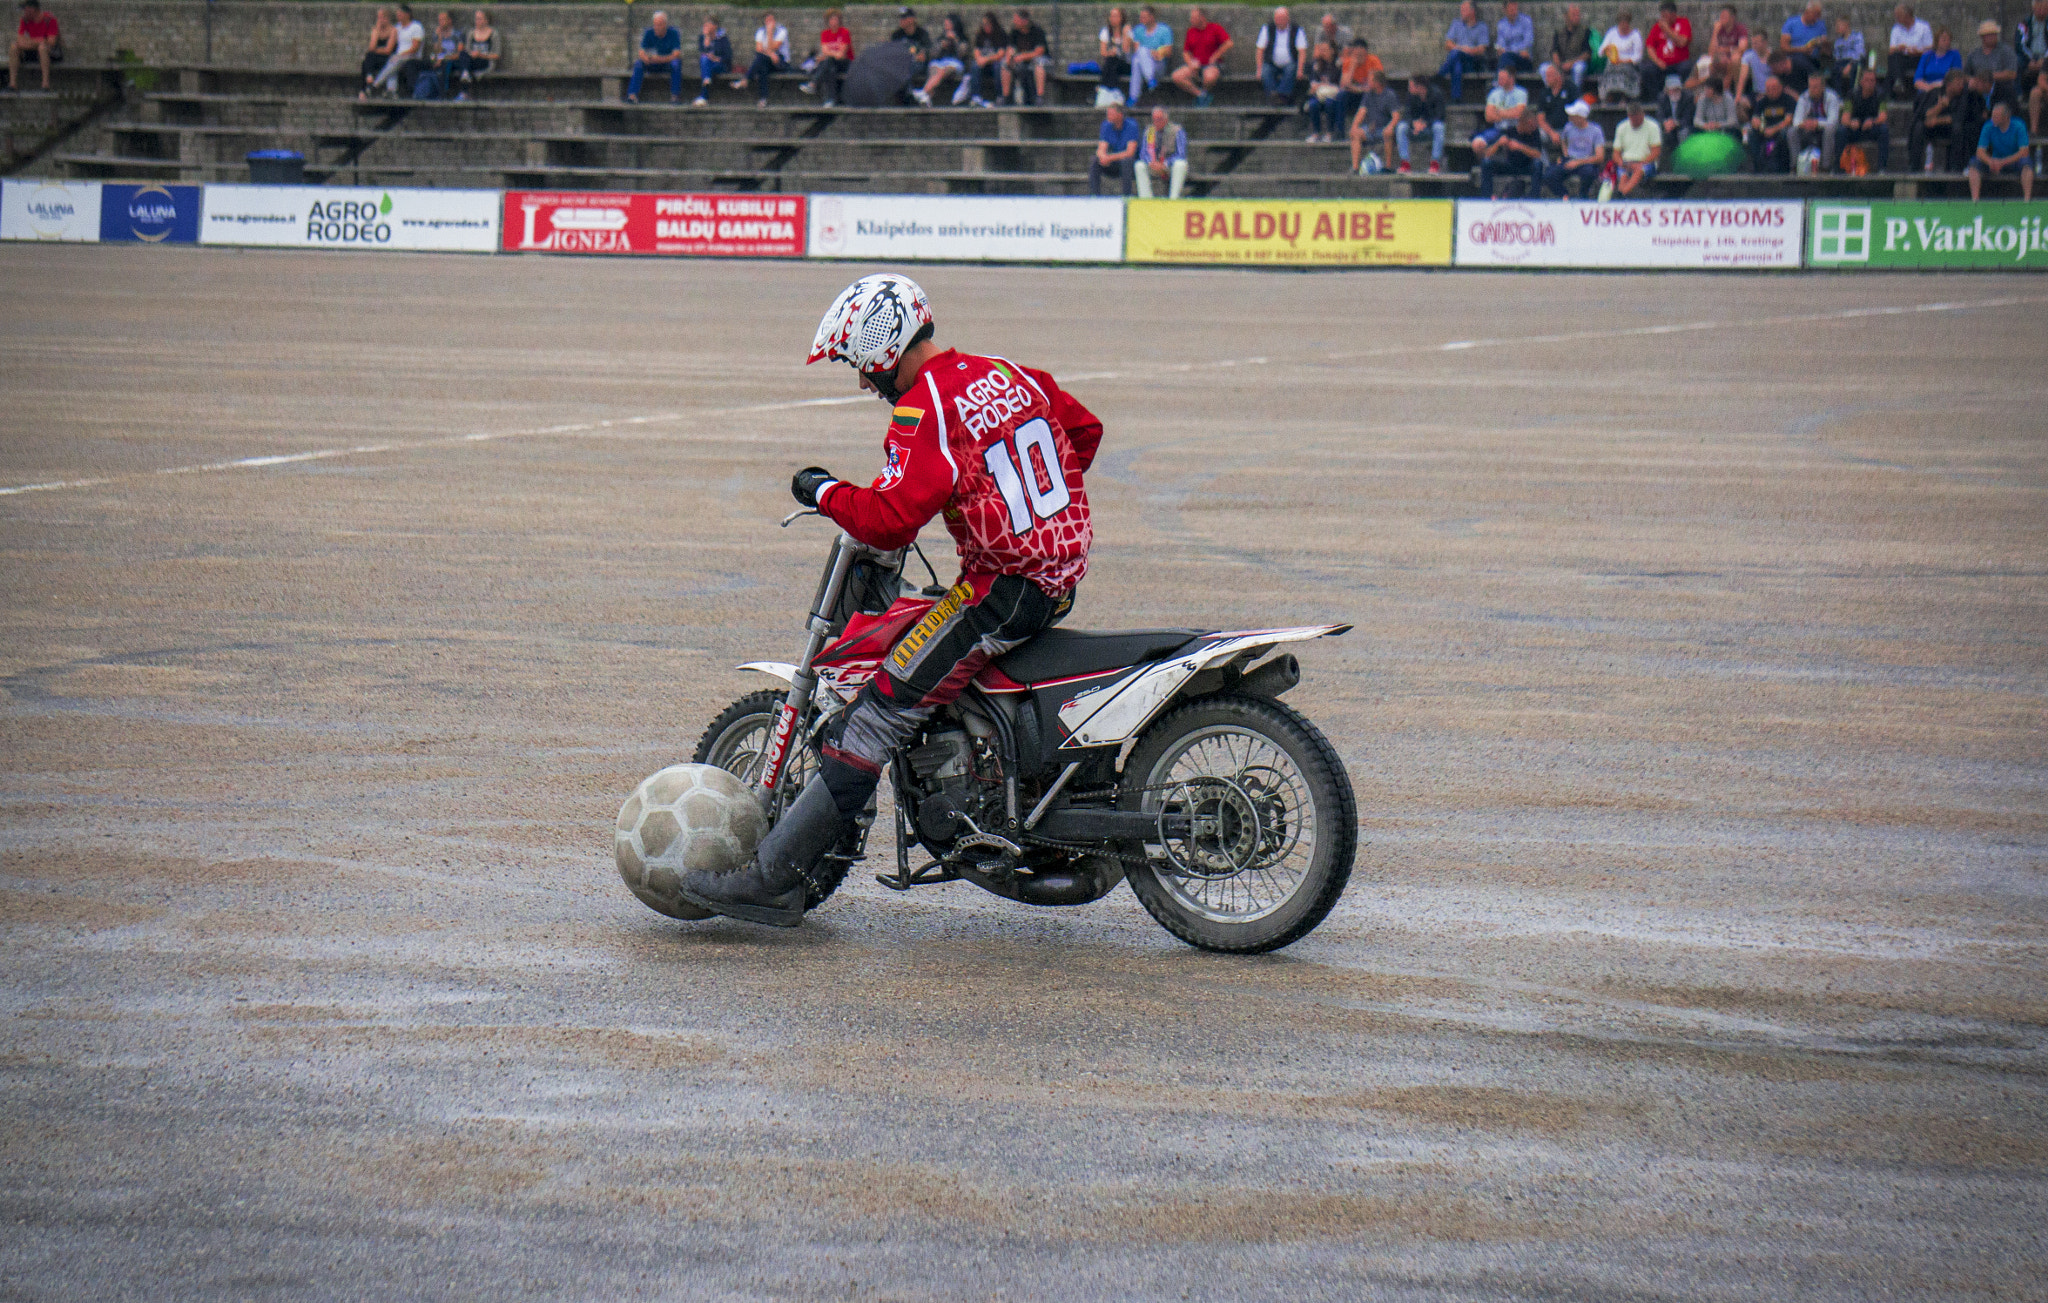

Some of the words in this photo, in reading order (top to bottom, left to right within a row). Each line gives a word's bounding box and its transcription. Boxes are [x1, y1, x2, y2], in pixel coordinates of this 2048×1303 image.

[129, 203, 177, 218] LALUNA
[308, 200, 378, 221] AGRO
[717, 199, 776, 220] KUBILŲ
[778, 200, 797, 216] IR
[1580, 207, 1652, 228] VISKAS
[1658, 208, 1785, 228] STATYBOMS
[307, 222, 392, 242] RODEO
[519, 204, 631, 250] LIGNEJA
[655, 219, 716, 242] BALDŲ
[718, 221, 795, 240] GAMYBA
[856, 219, 933, 239] Klaipėdos
[938, 220, 1044, 238] universitetinė
[1050, 222, 1113, 240] ligoninė
[1184, 210, 1301, 248] BALDŲ
[1312, 203, 1395, 240] AIBĖ
[953, 368, 1010, 423] AGRO
[964, 384, 1032, 442] RODEO
[983, 416, 1071, 538] 10
[760, 708, 795, 787] MOTUL
